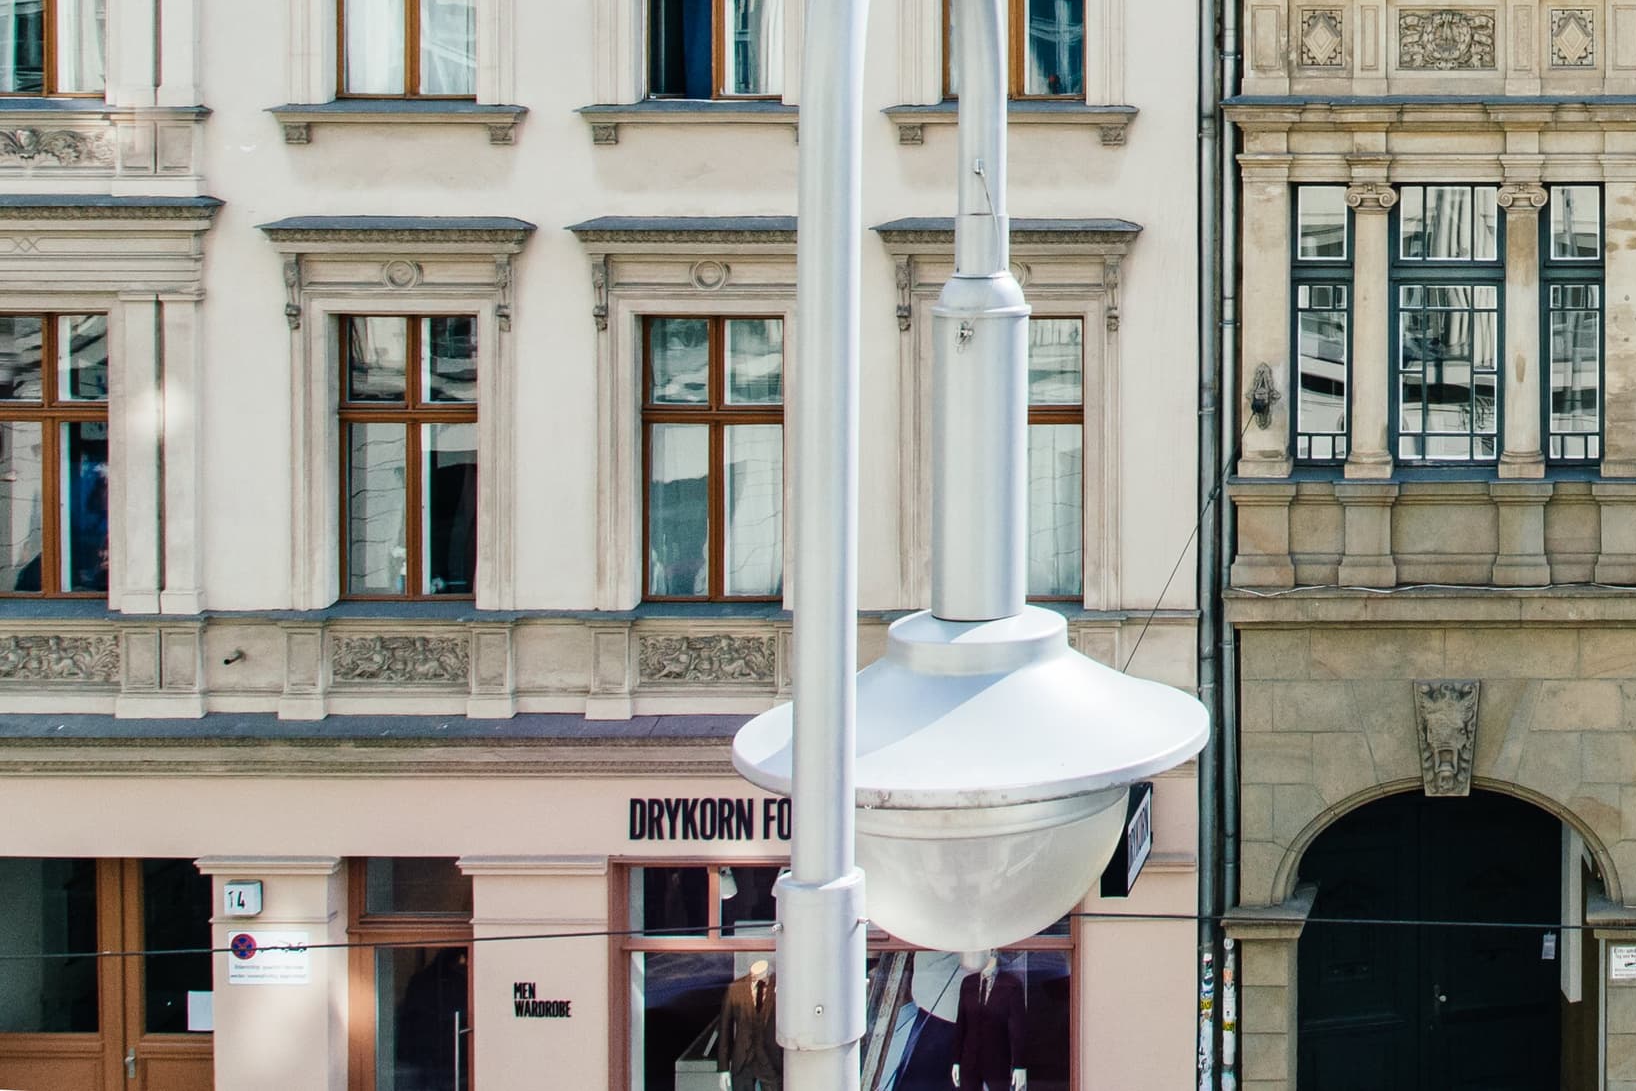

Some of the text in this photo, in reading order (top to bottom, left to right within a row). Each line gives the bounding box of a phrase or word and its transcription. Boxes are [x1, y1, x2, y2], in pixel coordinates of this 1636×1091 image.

[629, 798, 792, 841] DRYKORN FO
[228, 890, 246, 909] 14
[514, 982, 536, 999] MEN
[514, 1000, 572, 1018] WARDROBE
